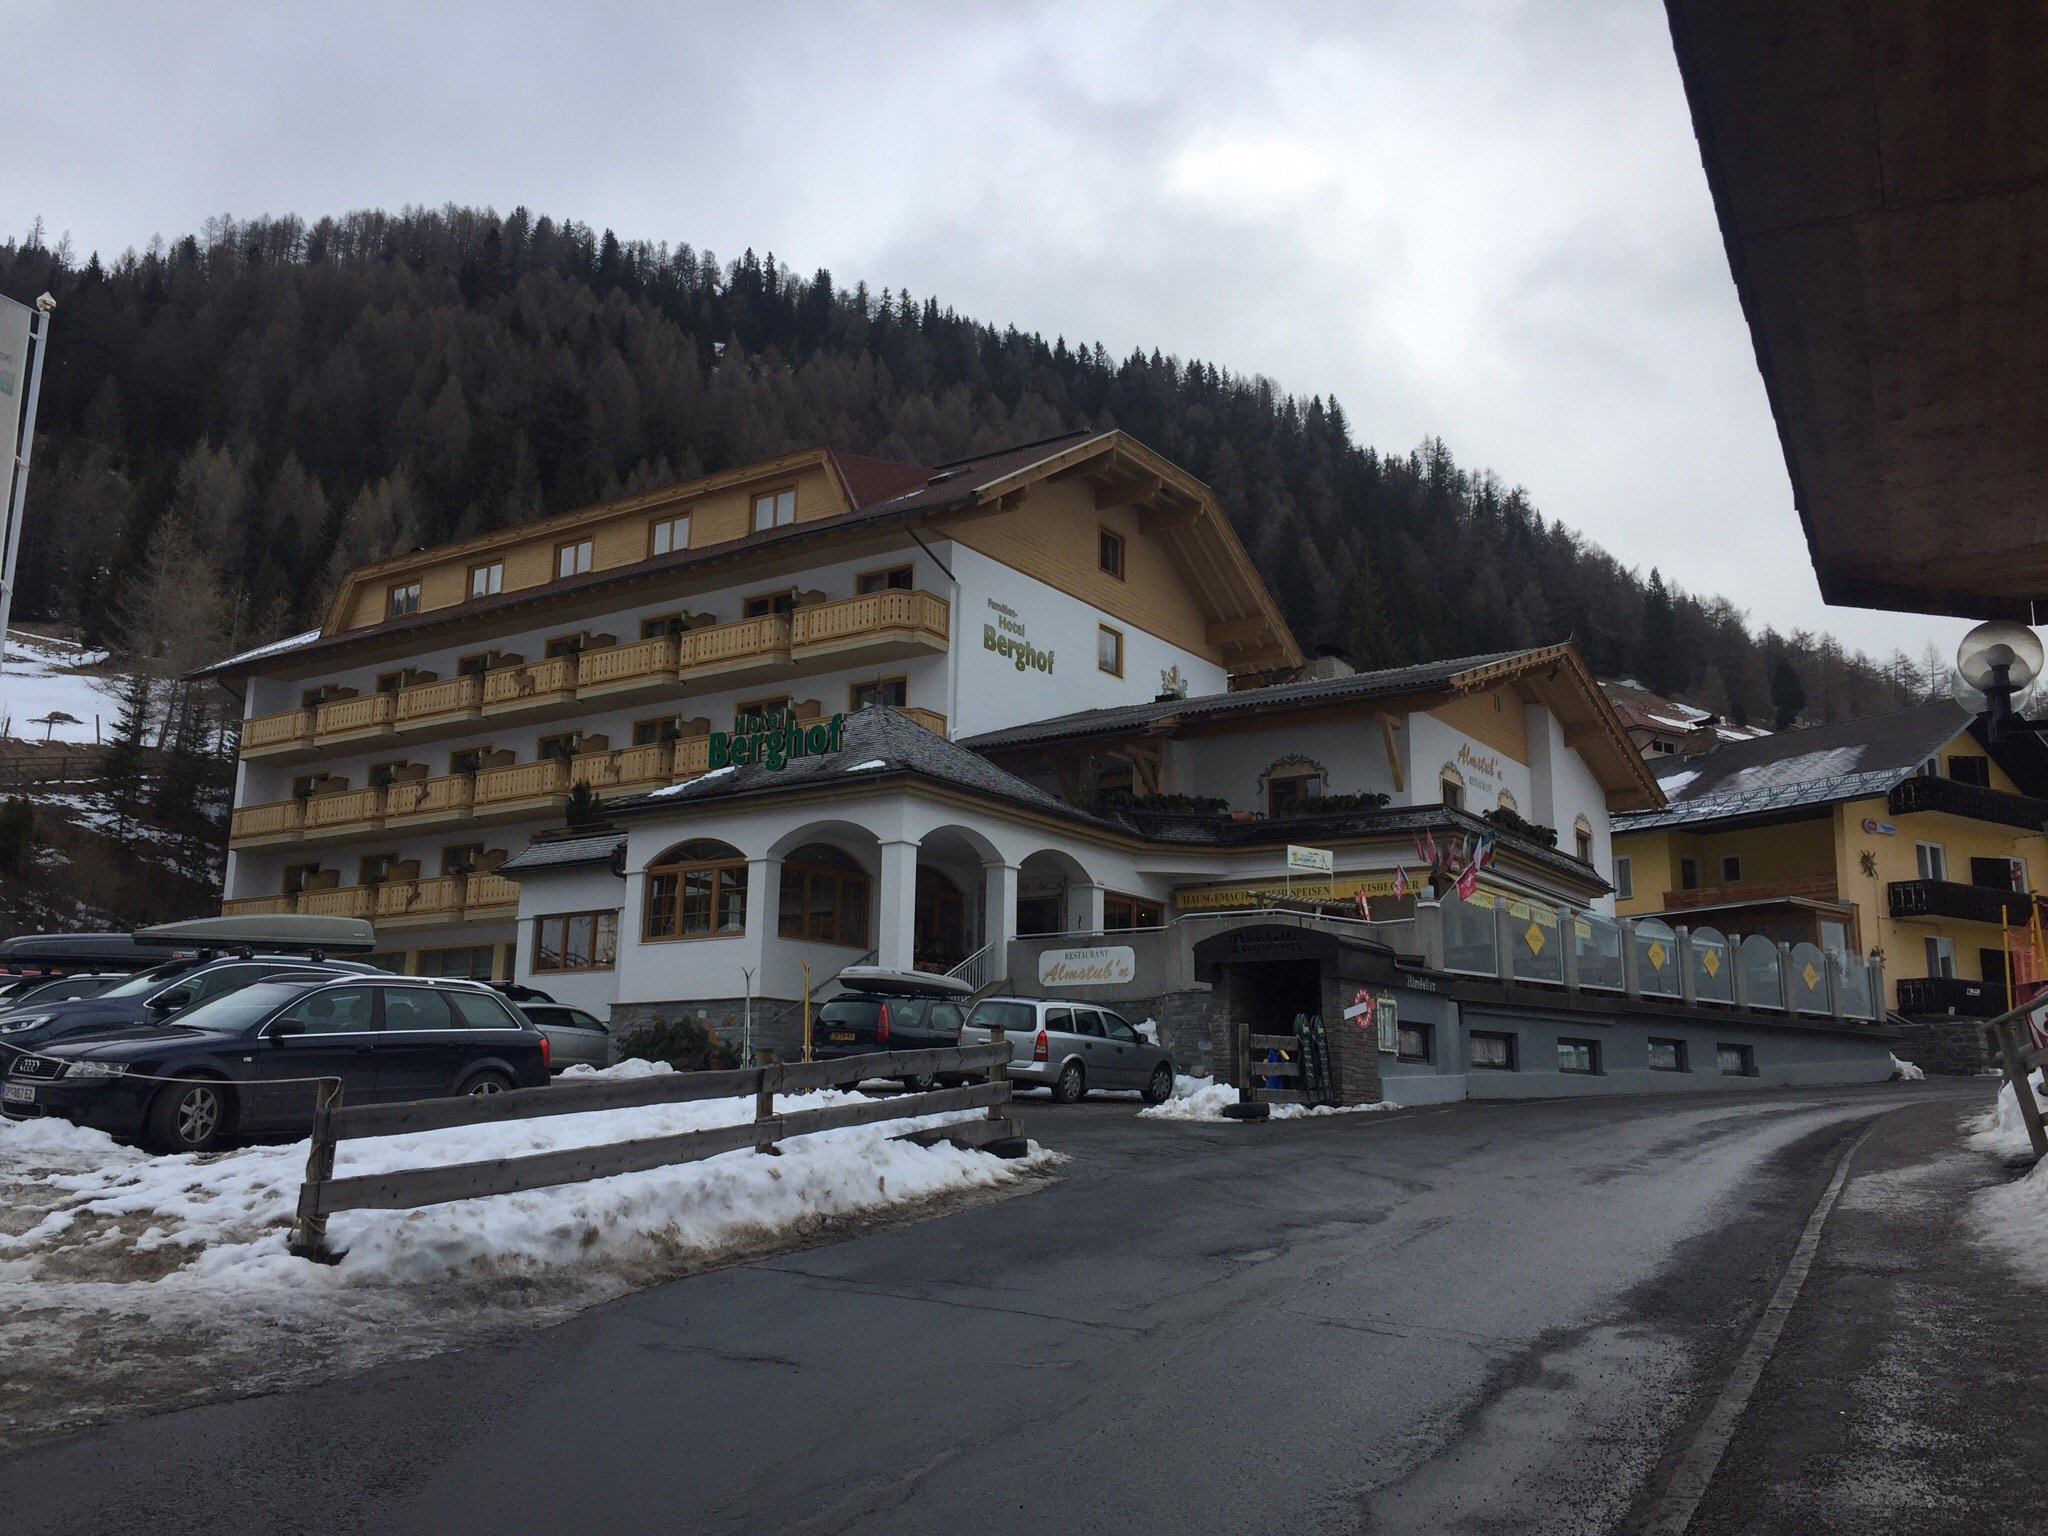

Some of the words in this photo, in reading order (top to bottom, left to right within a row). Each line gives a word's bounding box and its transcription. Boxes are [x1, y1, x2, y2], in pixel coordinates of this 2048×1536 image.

[998, 614, 1026, 638] Hotel
[983, 622, 1055, 675] Berghof
[735, 707, 787, 735] Hotel
[708, 713, 845, 772] Berghof
[1064, 950, 1108, 960] RESTAURANT
